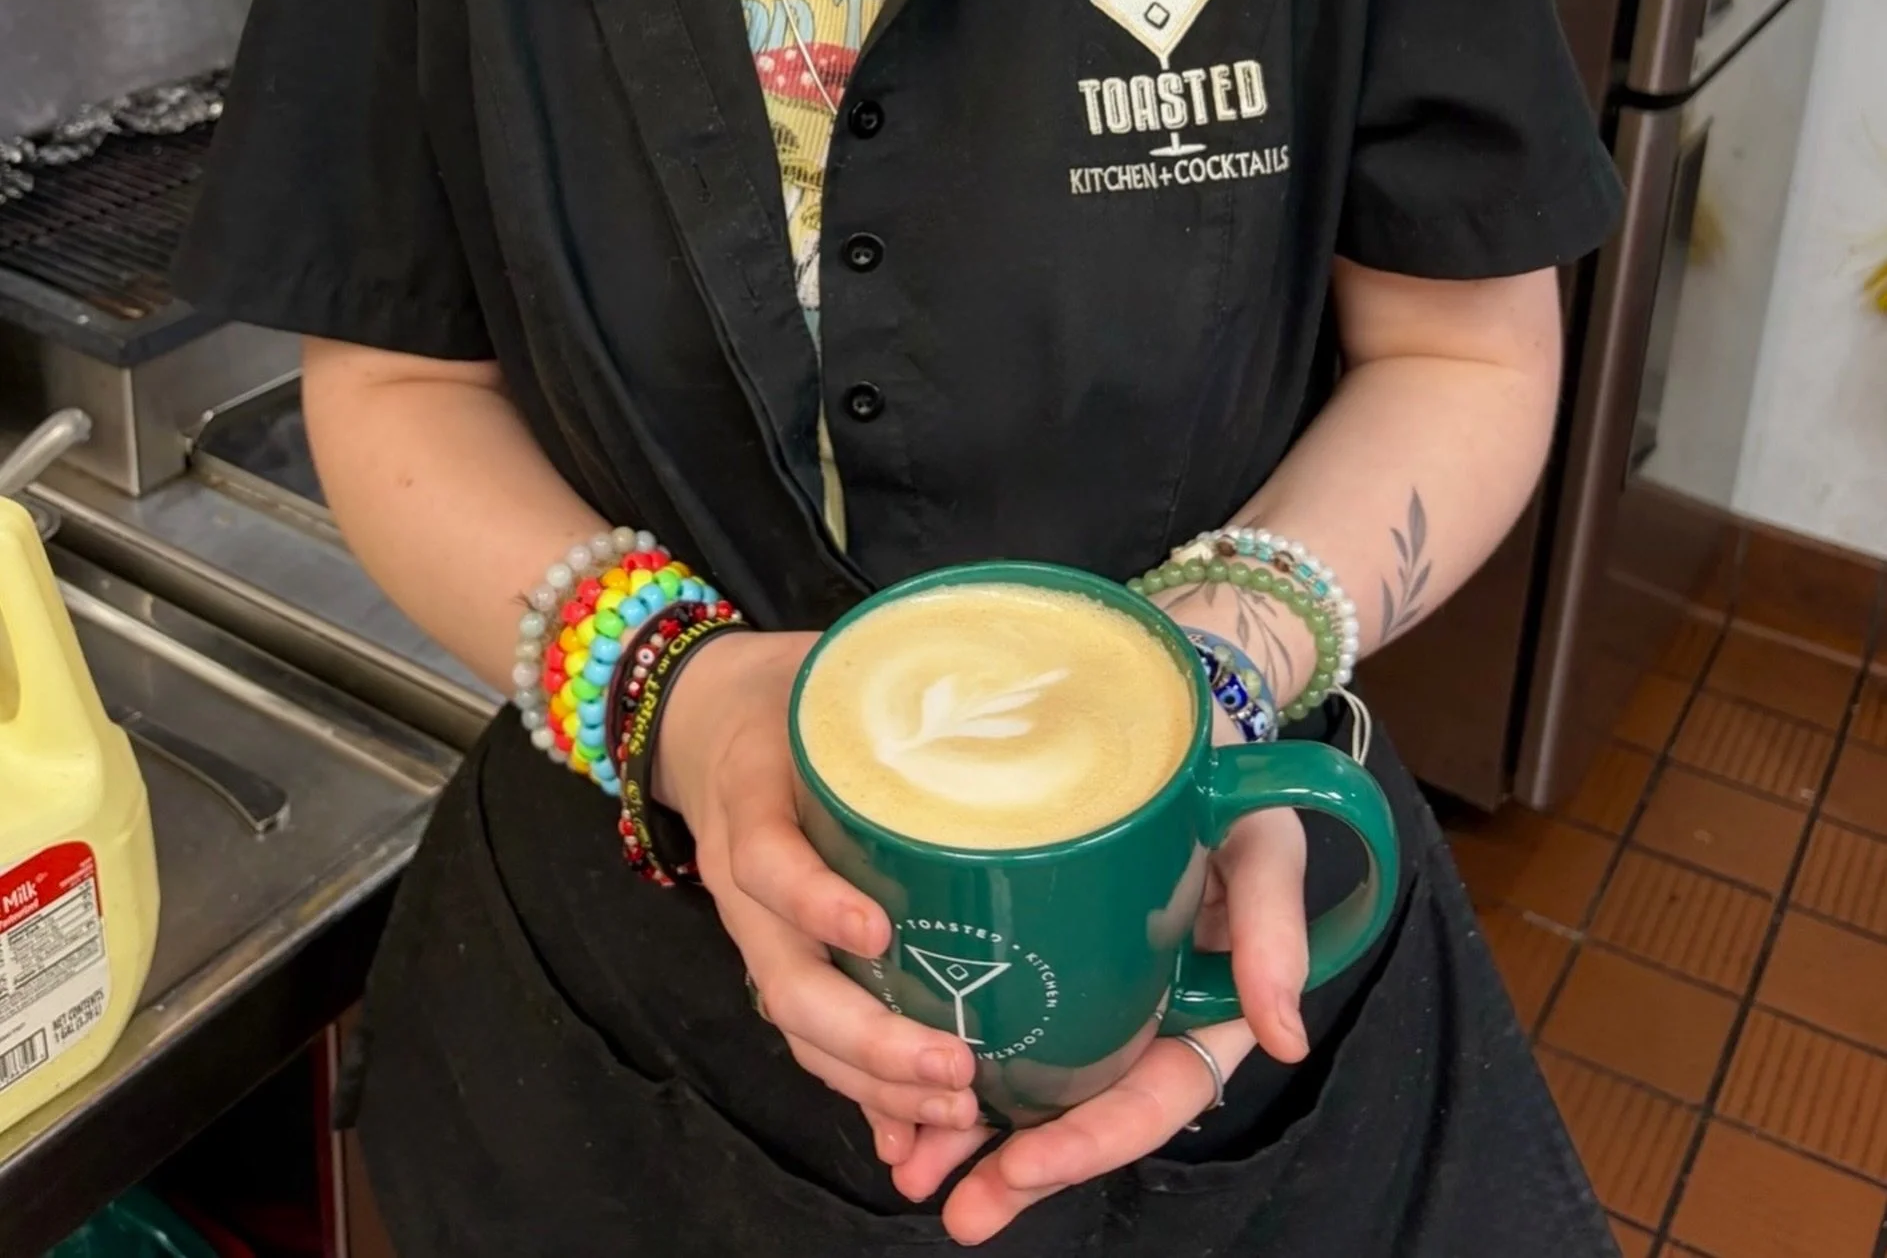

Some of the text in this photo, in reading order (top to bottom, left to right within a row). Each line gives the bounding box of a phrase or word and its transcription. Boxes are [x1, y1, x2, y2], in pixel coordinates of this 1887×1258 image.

[1078, 60, 1268, 135] TOASTED
[2, 880, 38, 913] Milk
[906, 918, 1060, 1060] TOASTED KITCHEN COCKTAI
